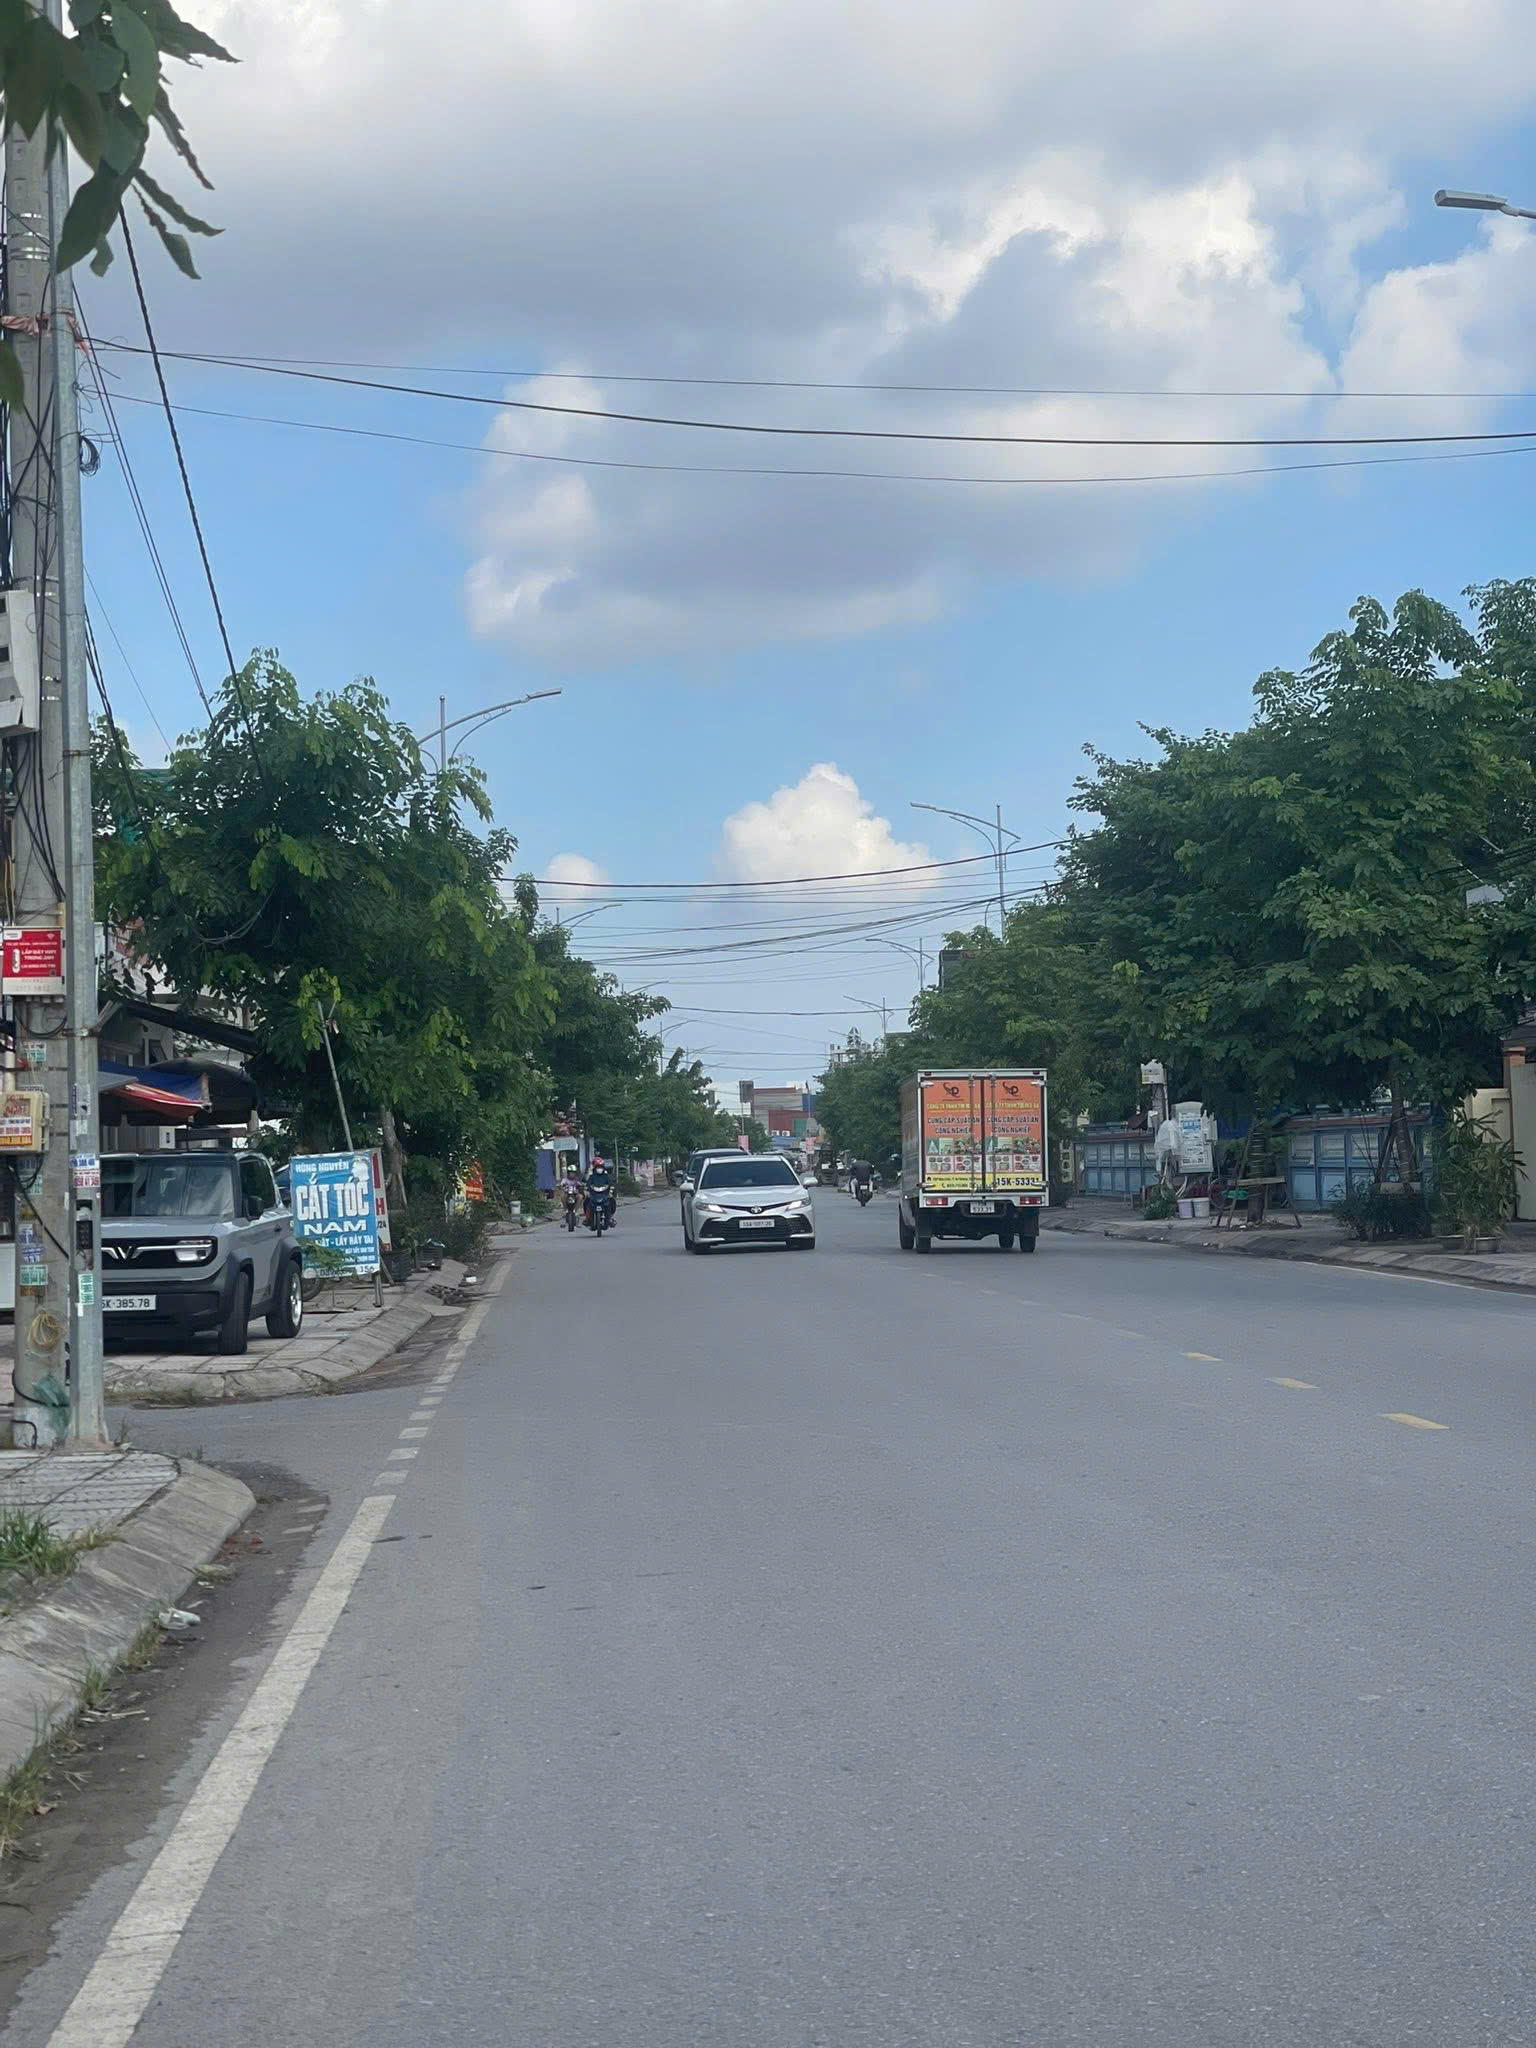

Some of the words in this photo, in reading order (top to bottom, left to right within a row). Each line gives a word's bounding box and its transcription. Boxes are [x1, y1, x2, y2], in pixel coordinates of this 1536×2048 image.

[296, 1173, 330, 1221] CẮT
[334, 1175, 370, 1217] TÓC
[303, 1219, 367, 1236] NAM
